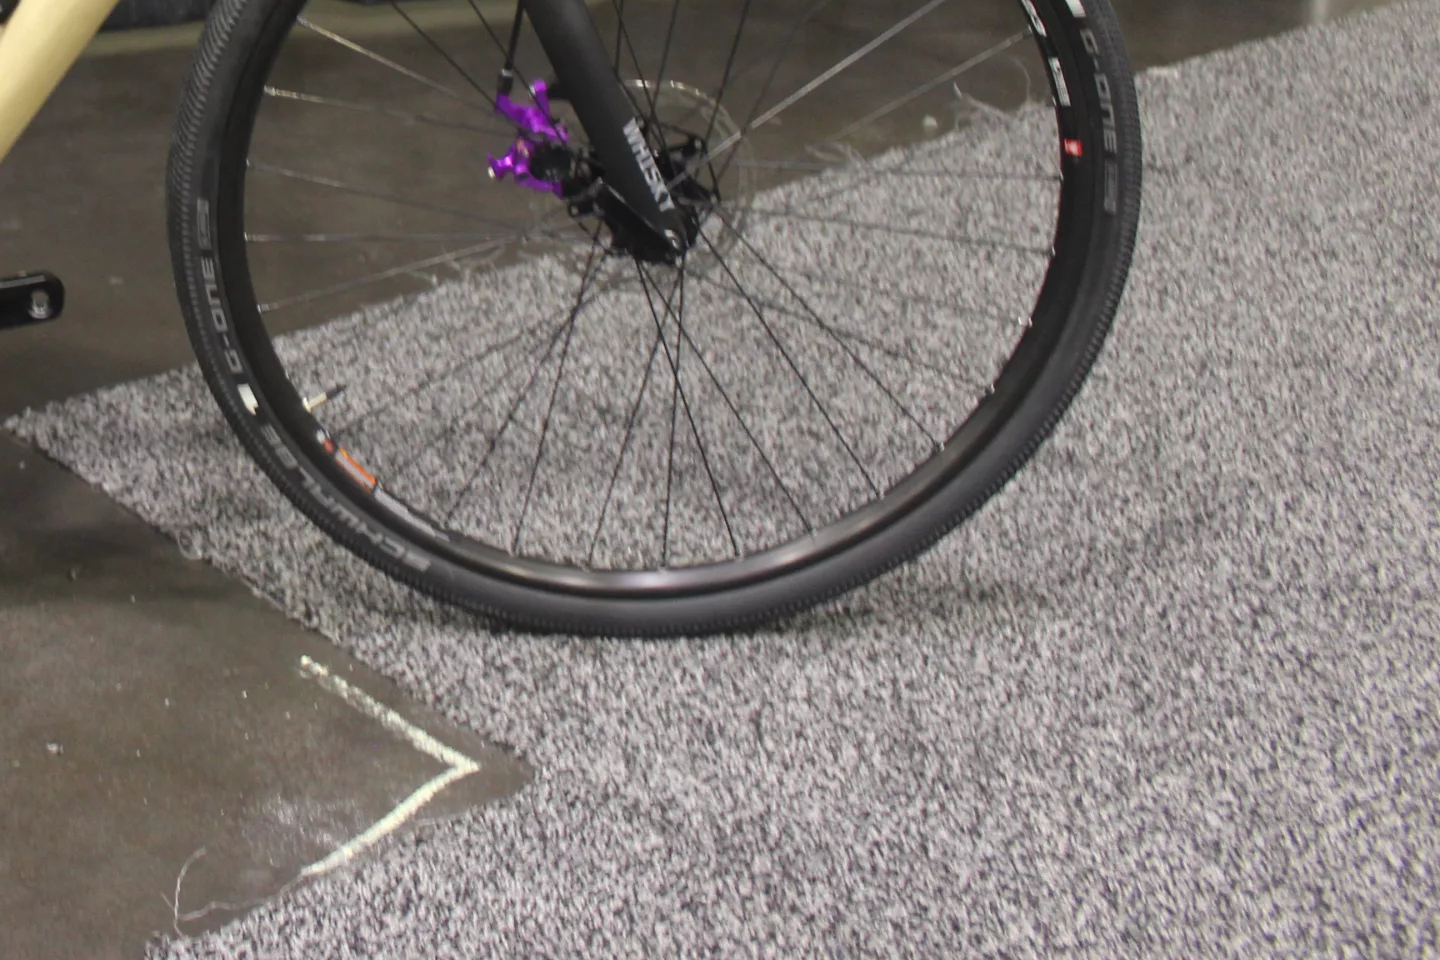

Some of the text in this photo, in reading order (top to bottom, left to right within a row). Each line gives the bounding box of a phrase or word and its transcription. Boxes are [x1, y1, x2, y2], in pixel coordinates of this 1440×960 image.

[1080, 28, 1118, 156] G-ONE
[622, 117, 675, 213] WHISKY
[200, 257, 243, 375] G-ONE
